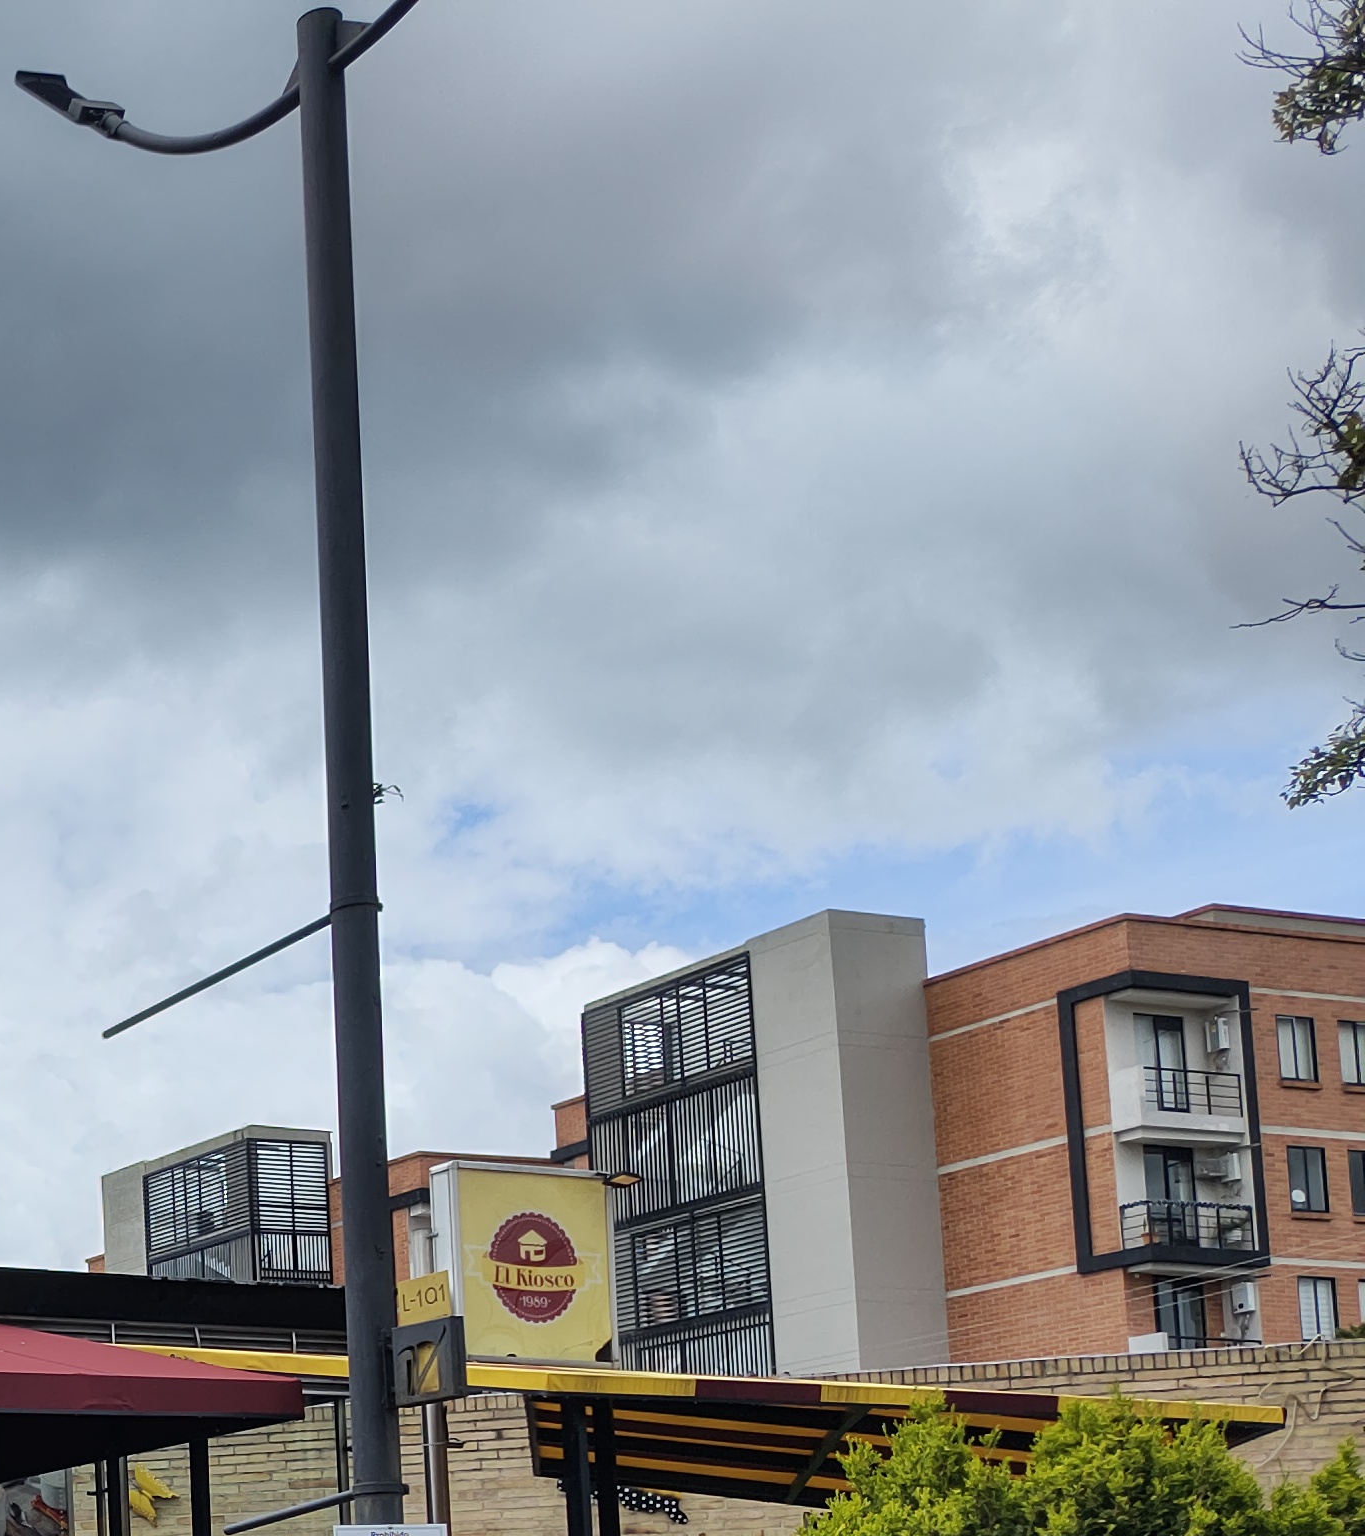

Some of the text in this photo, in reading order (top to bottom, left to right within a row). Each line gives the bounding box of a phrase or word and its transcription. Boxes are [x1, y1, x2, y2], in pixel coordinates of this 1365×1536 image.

[494, 1265, 575, 1288] El Kiosco
[402, 1283, 446, 1312] L-101
[522, 1295, 548, 1309] 1989
